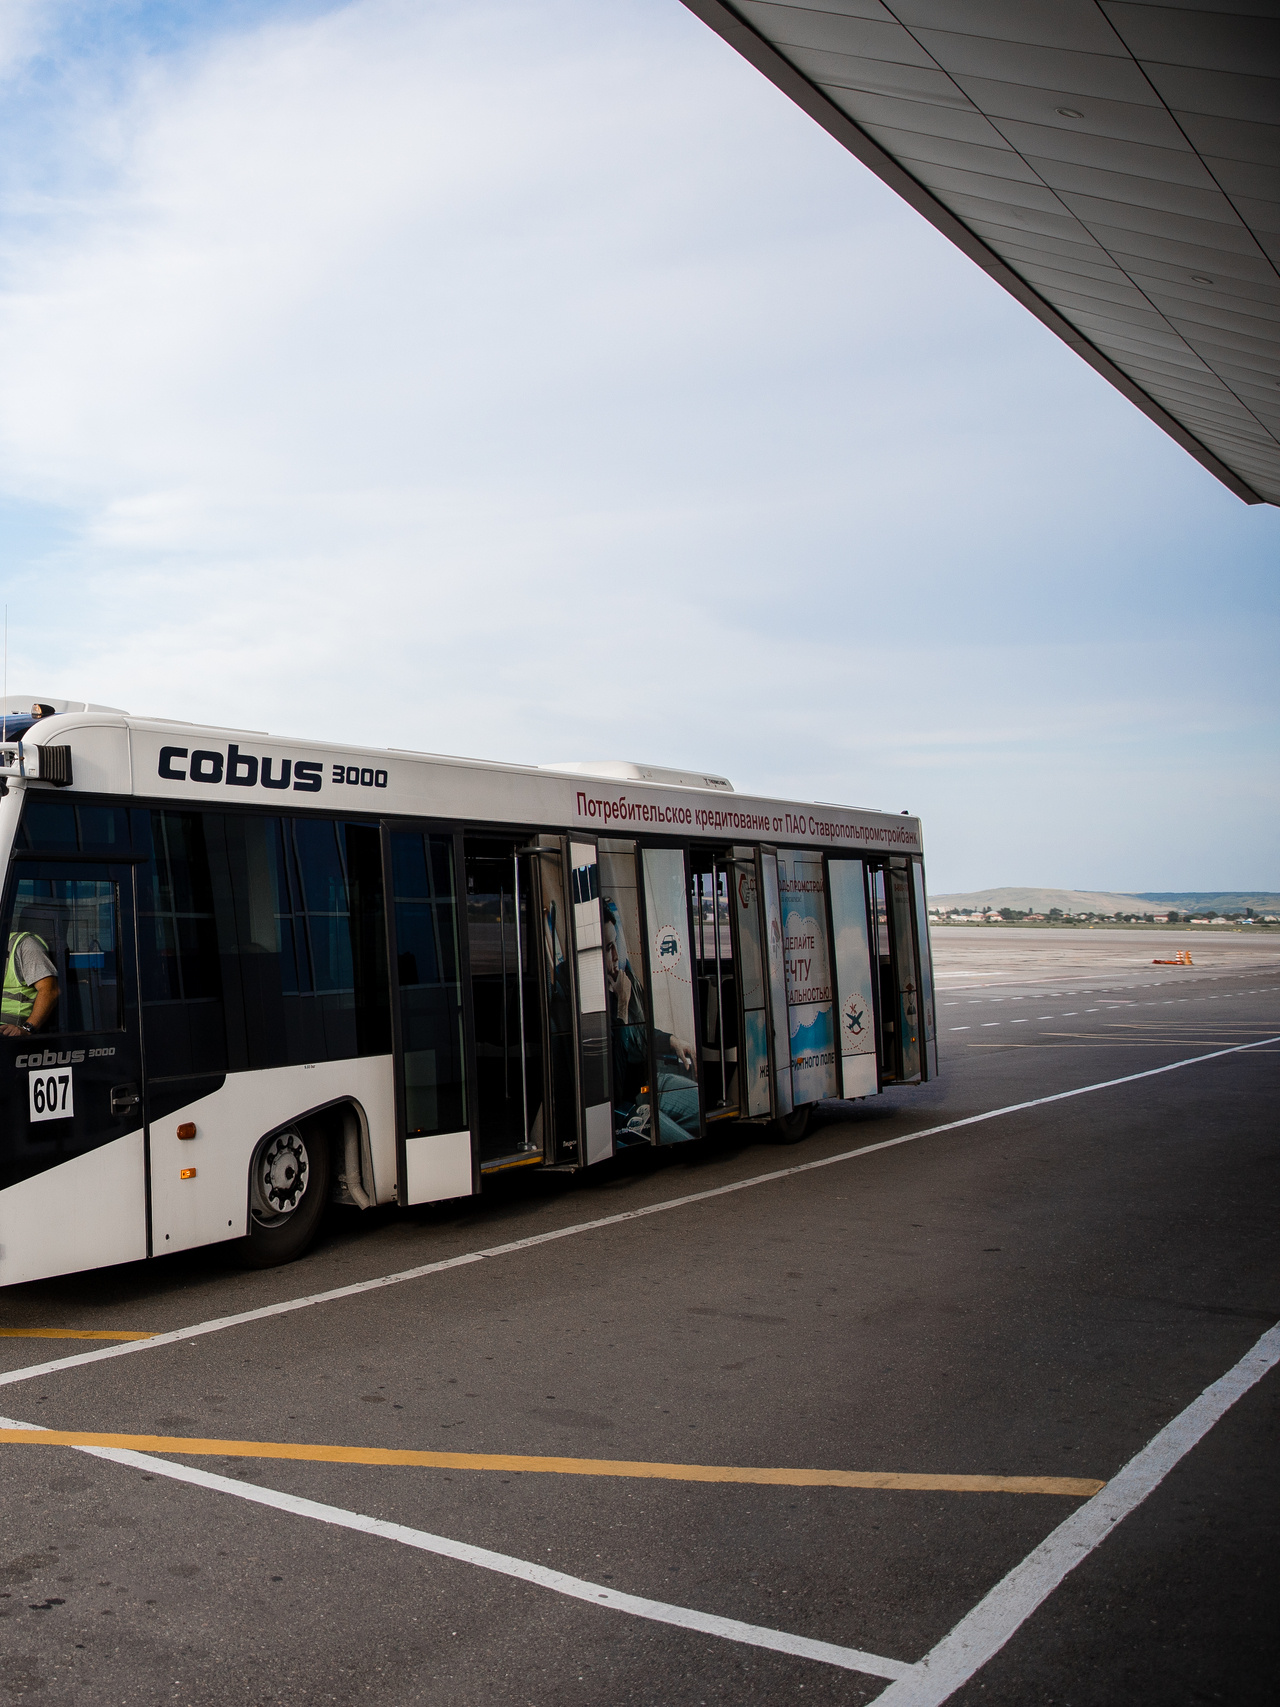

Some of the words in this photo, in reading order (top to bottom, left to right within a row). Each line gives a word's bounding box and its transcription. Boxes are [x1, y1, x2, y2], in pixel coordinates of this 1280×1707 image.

[158, 744, 324, 792] cobus
[332, 764, 388, 788] 3000
[577, 792, 692, 824] Потребительское
[695, 809, 770, 832] кредитование
[773, 817, 783, 832] от
[785, 814, 806, 834] ПАО
[808, 816, 918, 846] Ставропольпромстройбанк
[15, 1049, 85, 1068] cobus
[88, 1047, 115, 1057] 3000
[33, 1075, 70, 1114] 607
